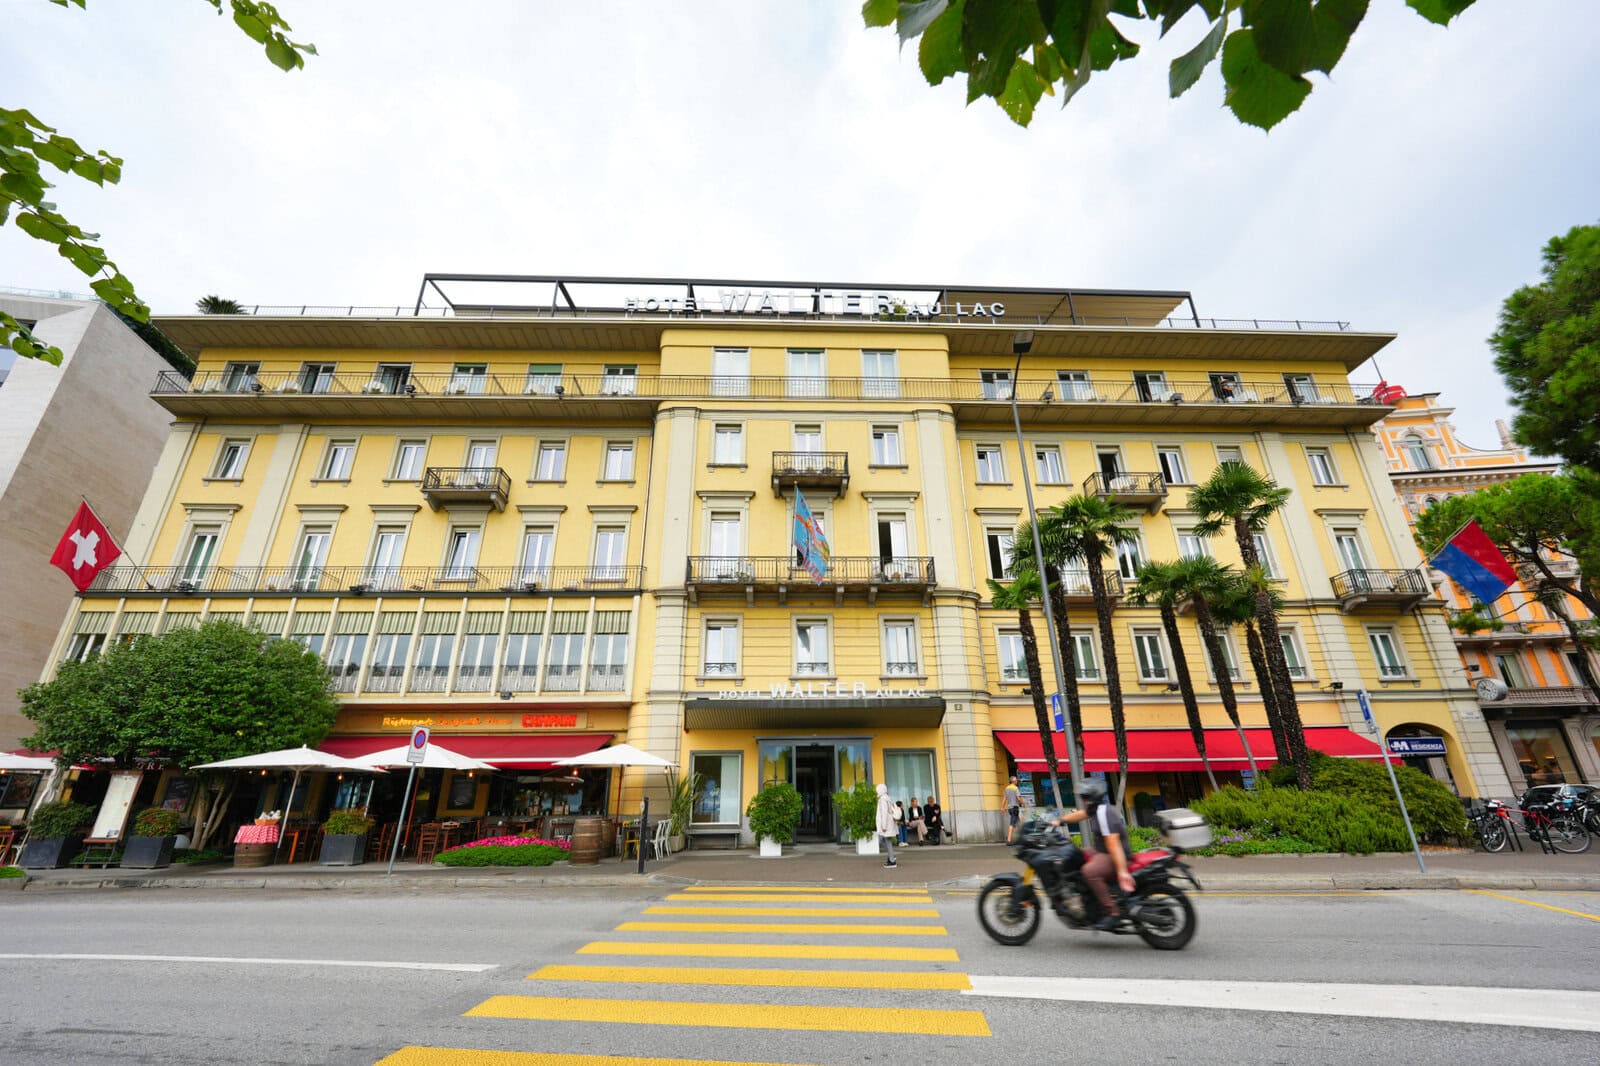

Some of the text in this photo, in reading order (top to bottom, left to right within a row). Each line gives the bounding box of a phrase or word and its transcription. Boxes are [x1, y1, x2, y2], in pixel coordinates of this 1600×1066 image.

[623, 288, 1006, 316] HOTEL WALTER AU LAC
[719, 689, 761, 698] HOTEL
[769, 680, 867, 698] WALTER
[875, 688, 894, 698] AU
[522, 714, 577, 728] CAMPARI
